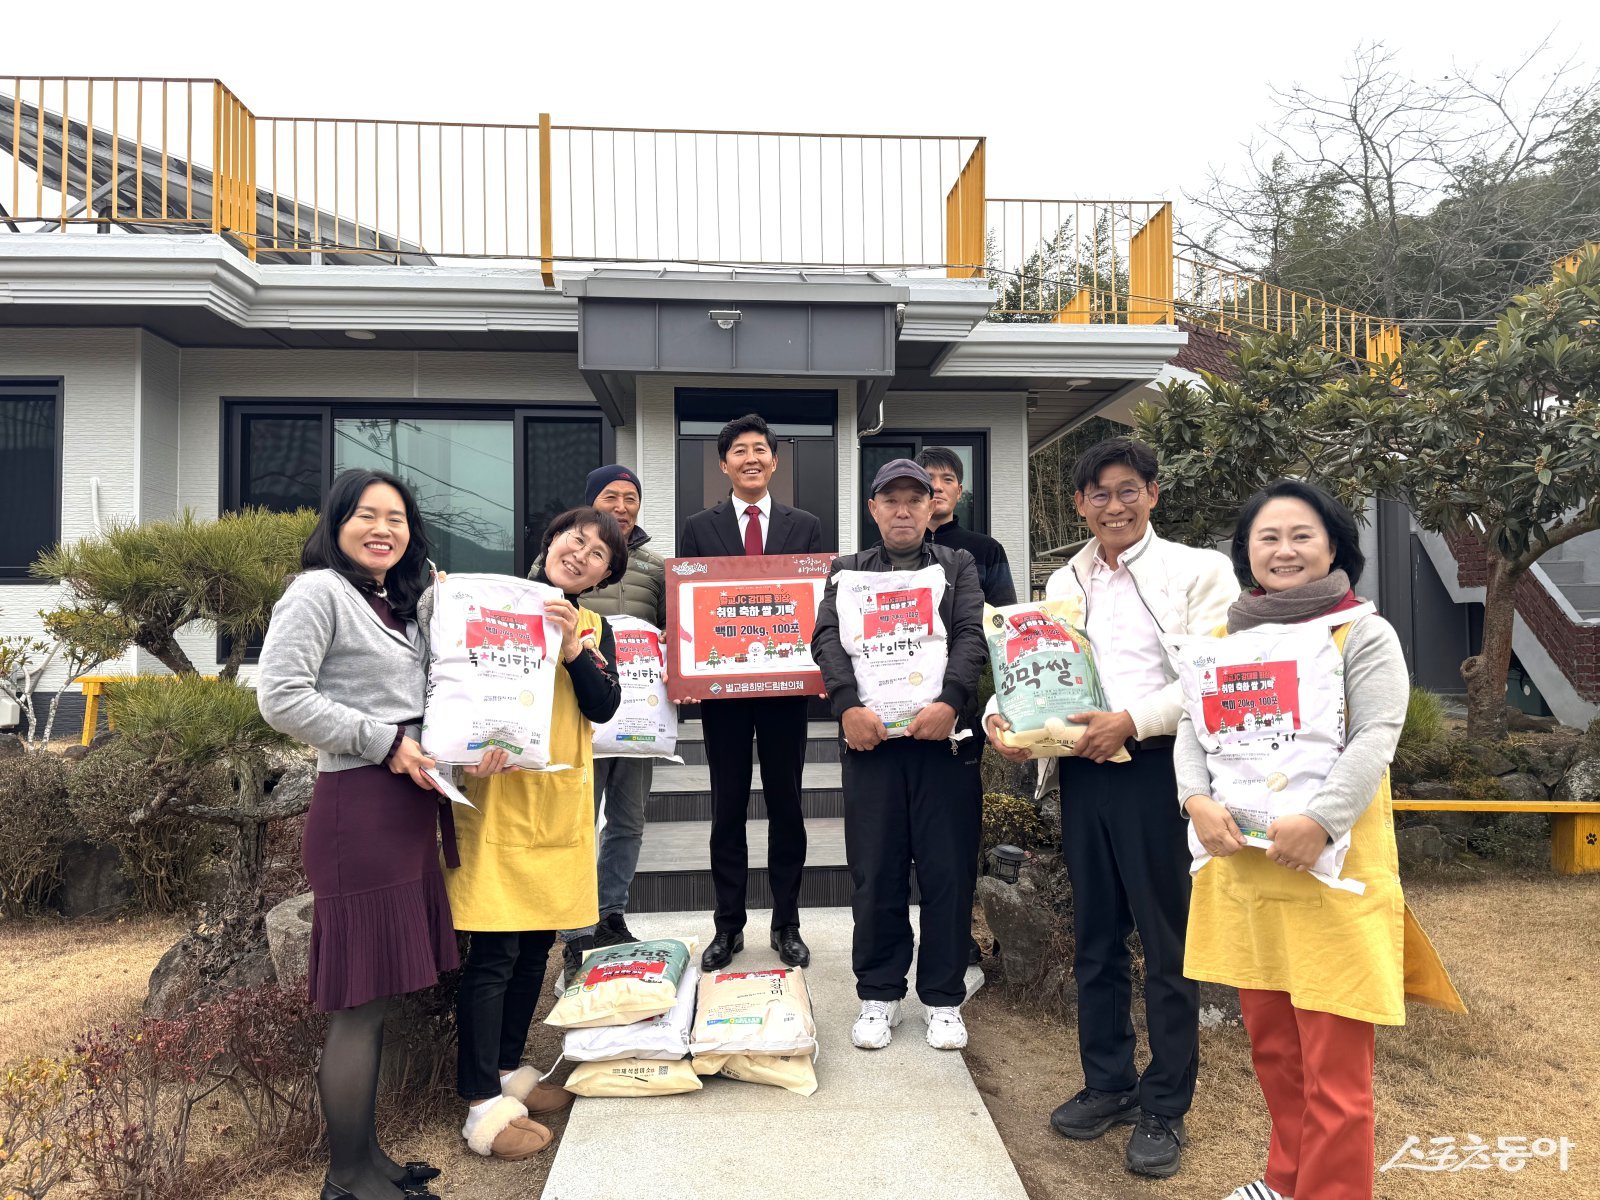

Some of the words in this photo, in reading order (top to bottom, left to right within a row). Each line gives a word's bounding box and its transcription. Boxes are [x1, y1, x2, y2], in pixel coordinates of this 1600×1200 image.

[716, 606, 737, 618] 취임
[739, 605, 760, 617] 축하
[761, 605, 773, 617] 쌀
[775, 604, 796, 616] 기탁
[715, 625, 737, 637] 백미
[740, 625, 769, 636] 20kg,
[772, 623, 800, 634] 100포
[1001, 658, 1074, 695] 꼬막쌀
[725, 680, 804, 693] 벌교읍희망드림협의체
[1260, 680, 1274, 690] 기탁
[1221, 700, 1236, 710] 백미
[1259, 696, 1278, 706] 100포
